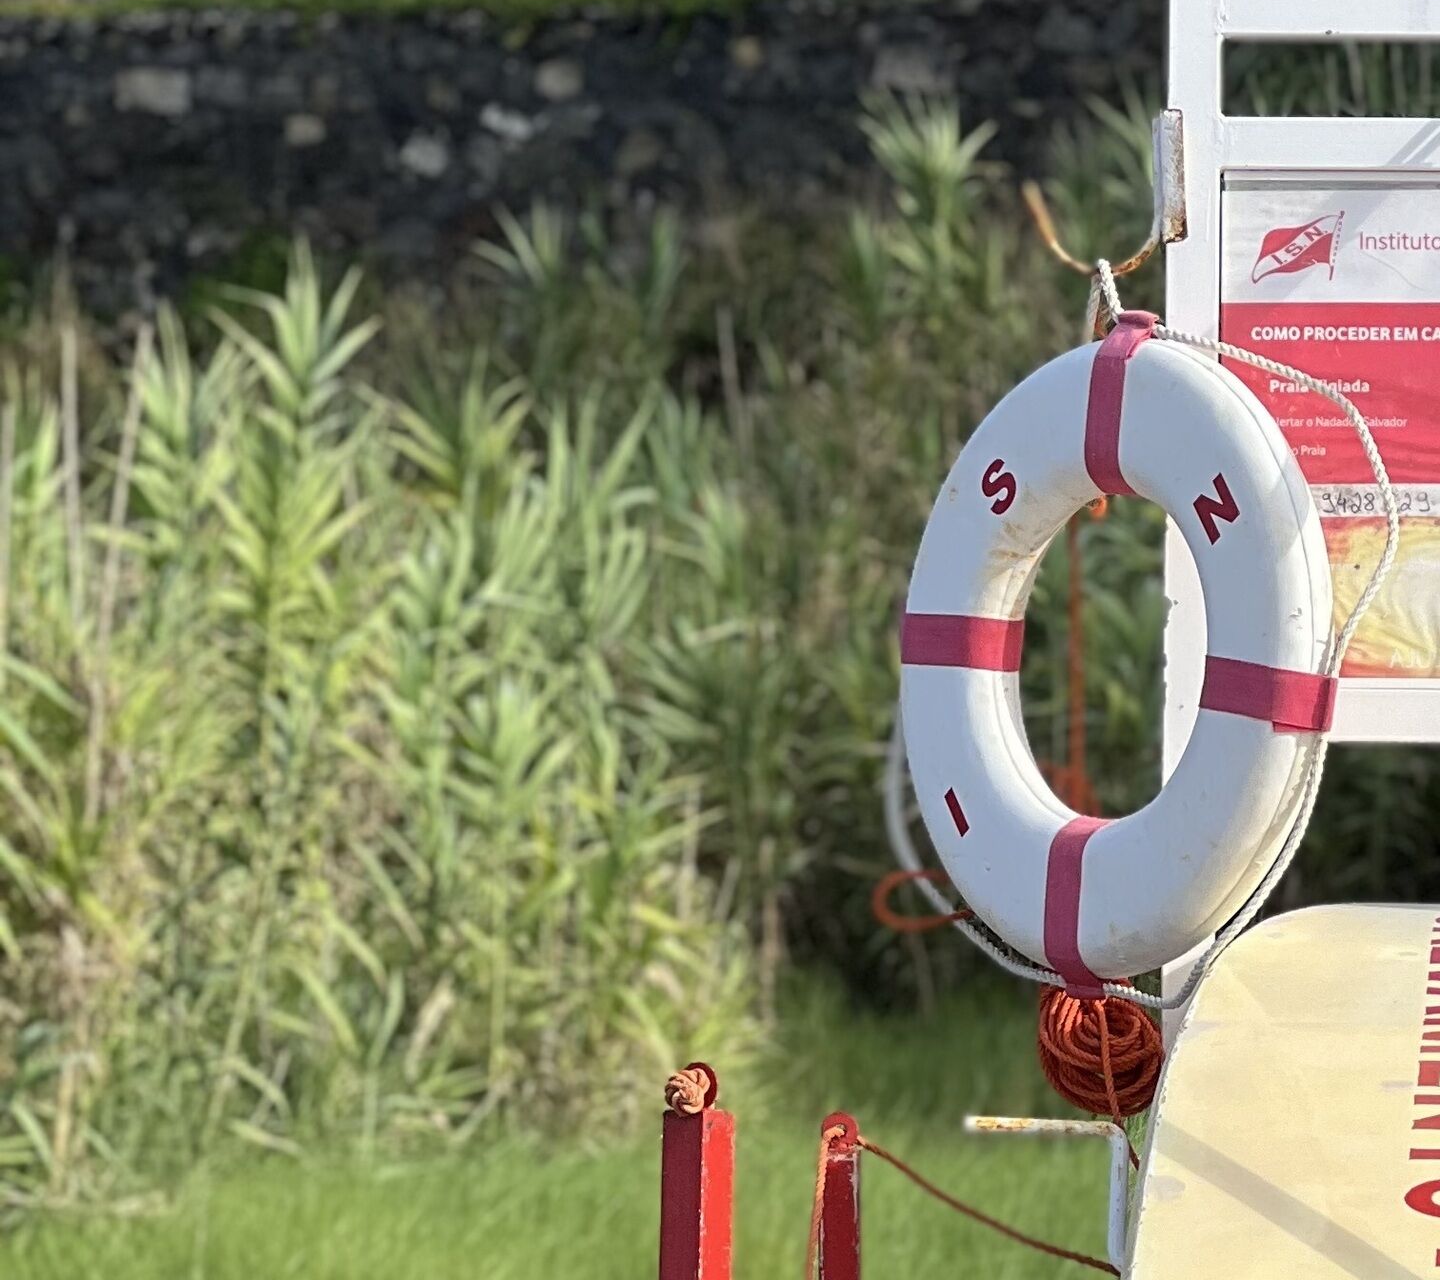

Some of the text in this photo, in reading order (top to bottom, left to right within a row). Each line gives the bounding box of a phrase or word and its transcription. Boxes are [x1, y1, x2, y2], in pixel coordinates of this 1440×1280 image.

[1251, 326, 1301, 341] COMO
[1303, 326, 1390, 341] PROCEDER
[1393, 326, 1418, 341] EM
[1301, 444, 1326, 456] Praia
[981, 458, 1017, 515] S
[1192, 472, 1241, 546] N
